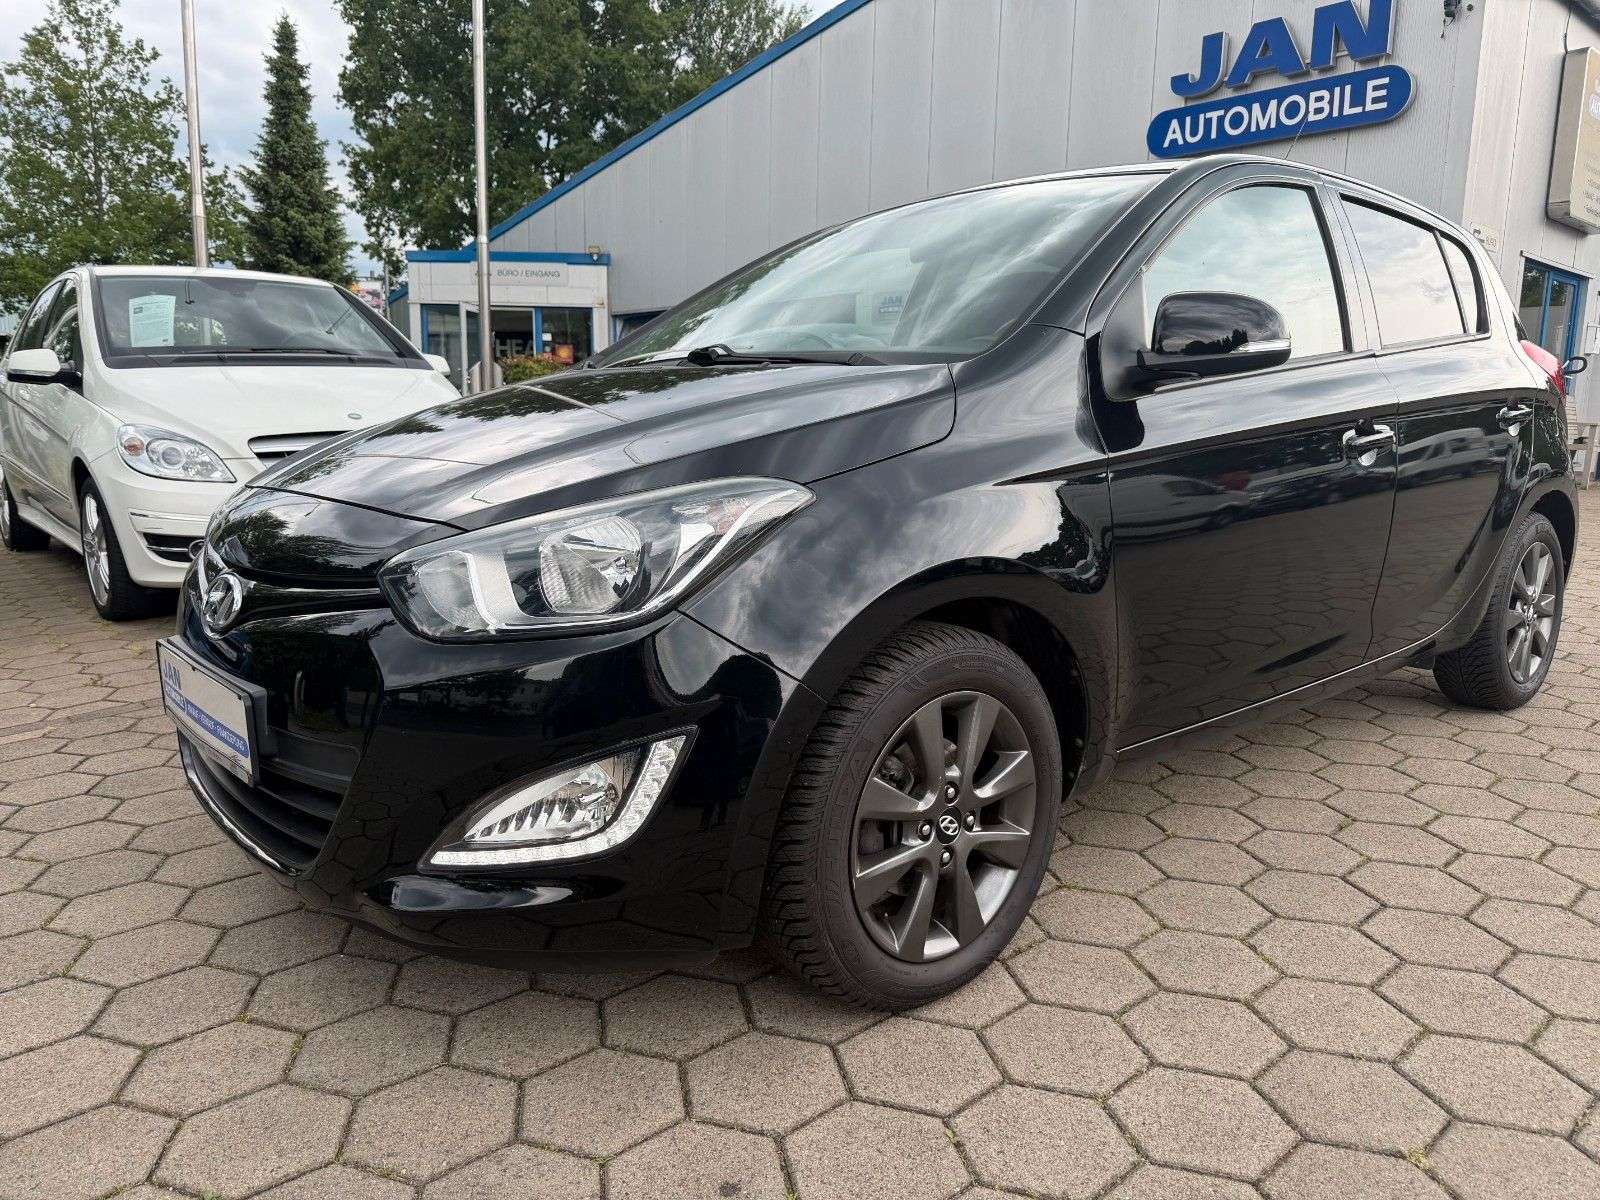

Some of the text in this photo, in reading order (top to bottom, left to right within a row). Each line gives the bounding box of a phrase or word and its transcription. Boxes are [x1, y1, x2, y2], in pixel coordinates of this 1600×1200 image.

[1170, 0, 1394, 98] JAN
[1162, 76, 1390, 149] AUTOMOBILE
[525, 269, 561, 279] EINGANG
[163, 657, 181, 691] JAN
